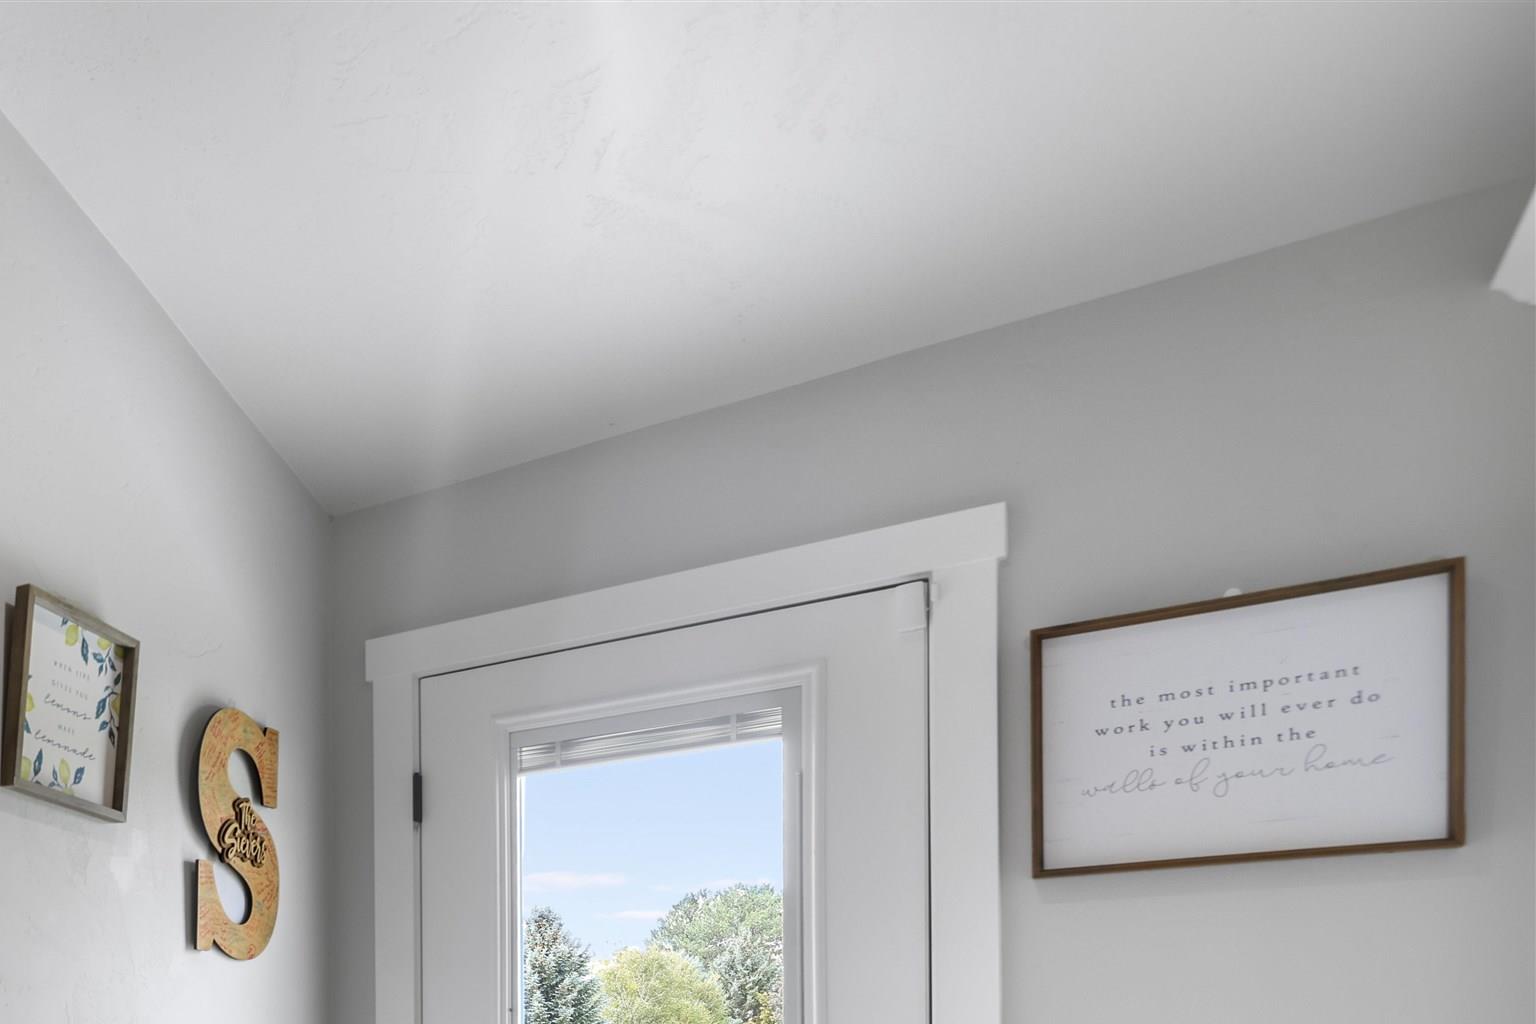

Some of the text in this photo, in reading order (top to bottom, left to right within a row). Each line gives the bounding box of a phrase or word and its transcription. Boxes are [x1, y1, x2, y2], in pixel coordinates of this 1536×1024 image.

[1109, 663, 1362, 710] the most important
[1094, 688, 1382, 738] work you will ever do
[33, 729, 97, 760] lemonade
[1149, 726, 1318, 758] is within the
[1080, 744, 1395, 799] walls of your home
[194, 707, 280, 961] S
[238, 802, 257, 831] The
